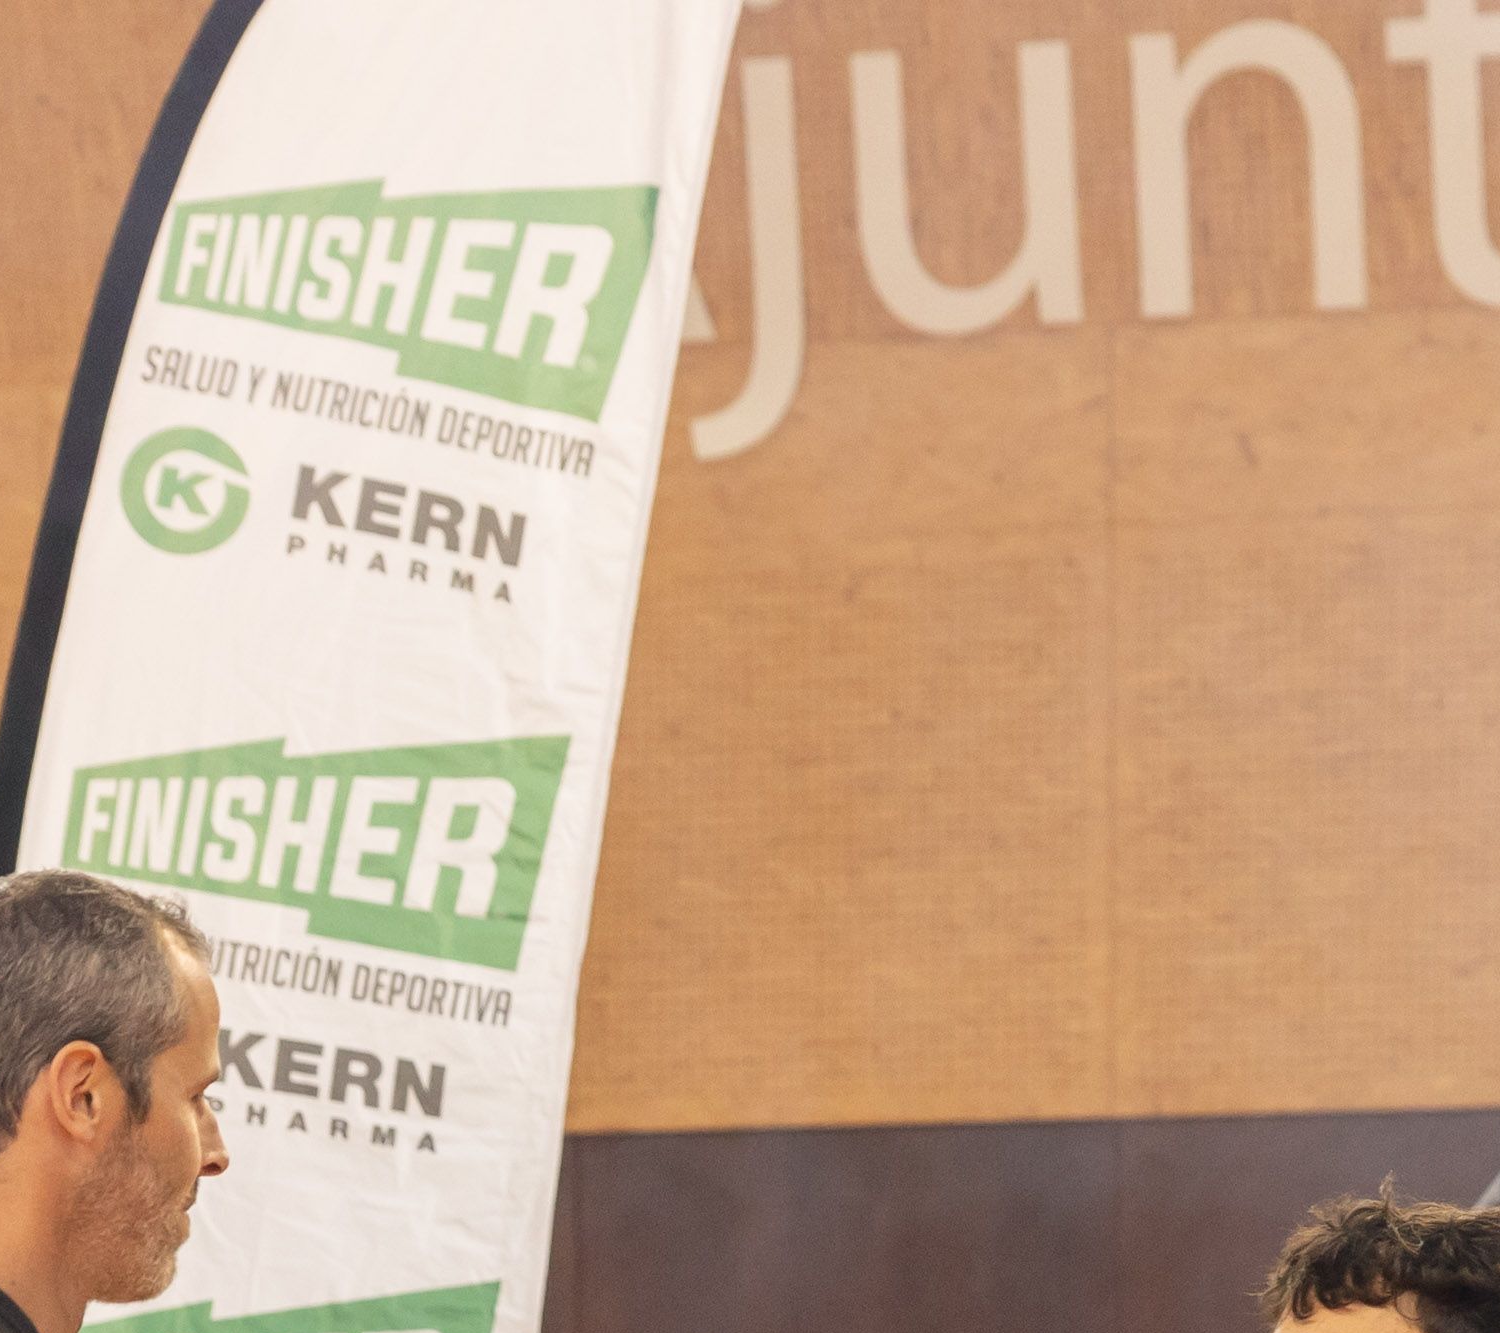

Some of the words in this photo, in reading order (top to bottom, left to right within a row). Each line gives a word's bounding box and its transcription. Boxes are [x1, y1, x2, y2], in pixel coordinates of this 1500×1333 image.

[173, 211, 614, 369] FINISHER
[141, 345, 239, 398] SALUD
[247, 366, 267, 409] Y
[271, 370, 430, 440] NUTRICIÓN
[436, 404, 597, 478] DEPORTIVA
[291, 463, 528, 569] KERN
[286, 534, 514, 605] PHARMA
[77, 774, 518, 918] FINISHER
[350, 962, 514, 1027] DEPORTIVA
[218, 1027, 447, 1118] KERN
